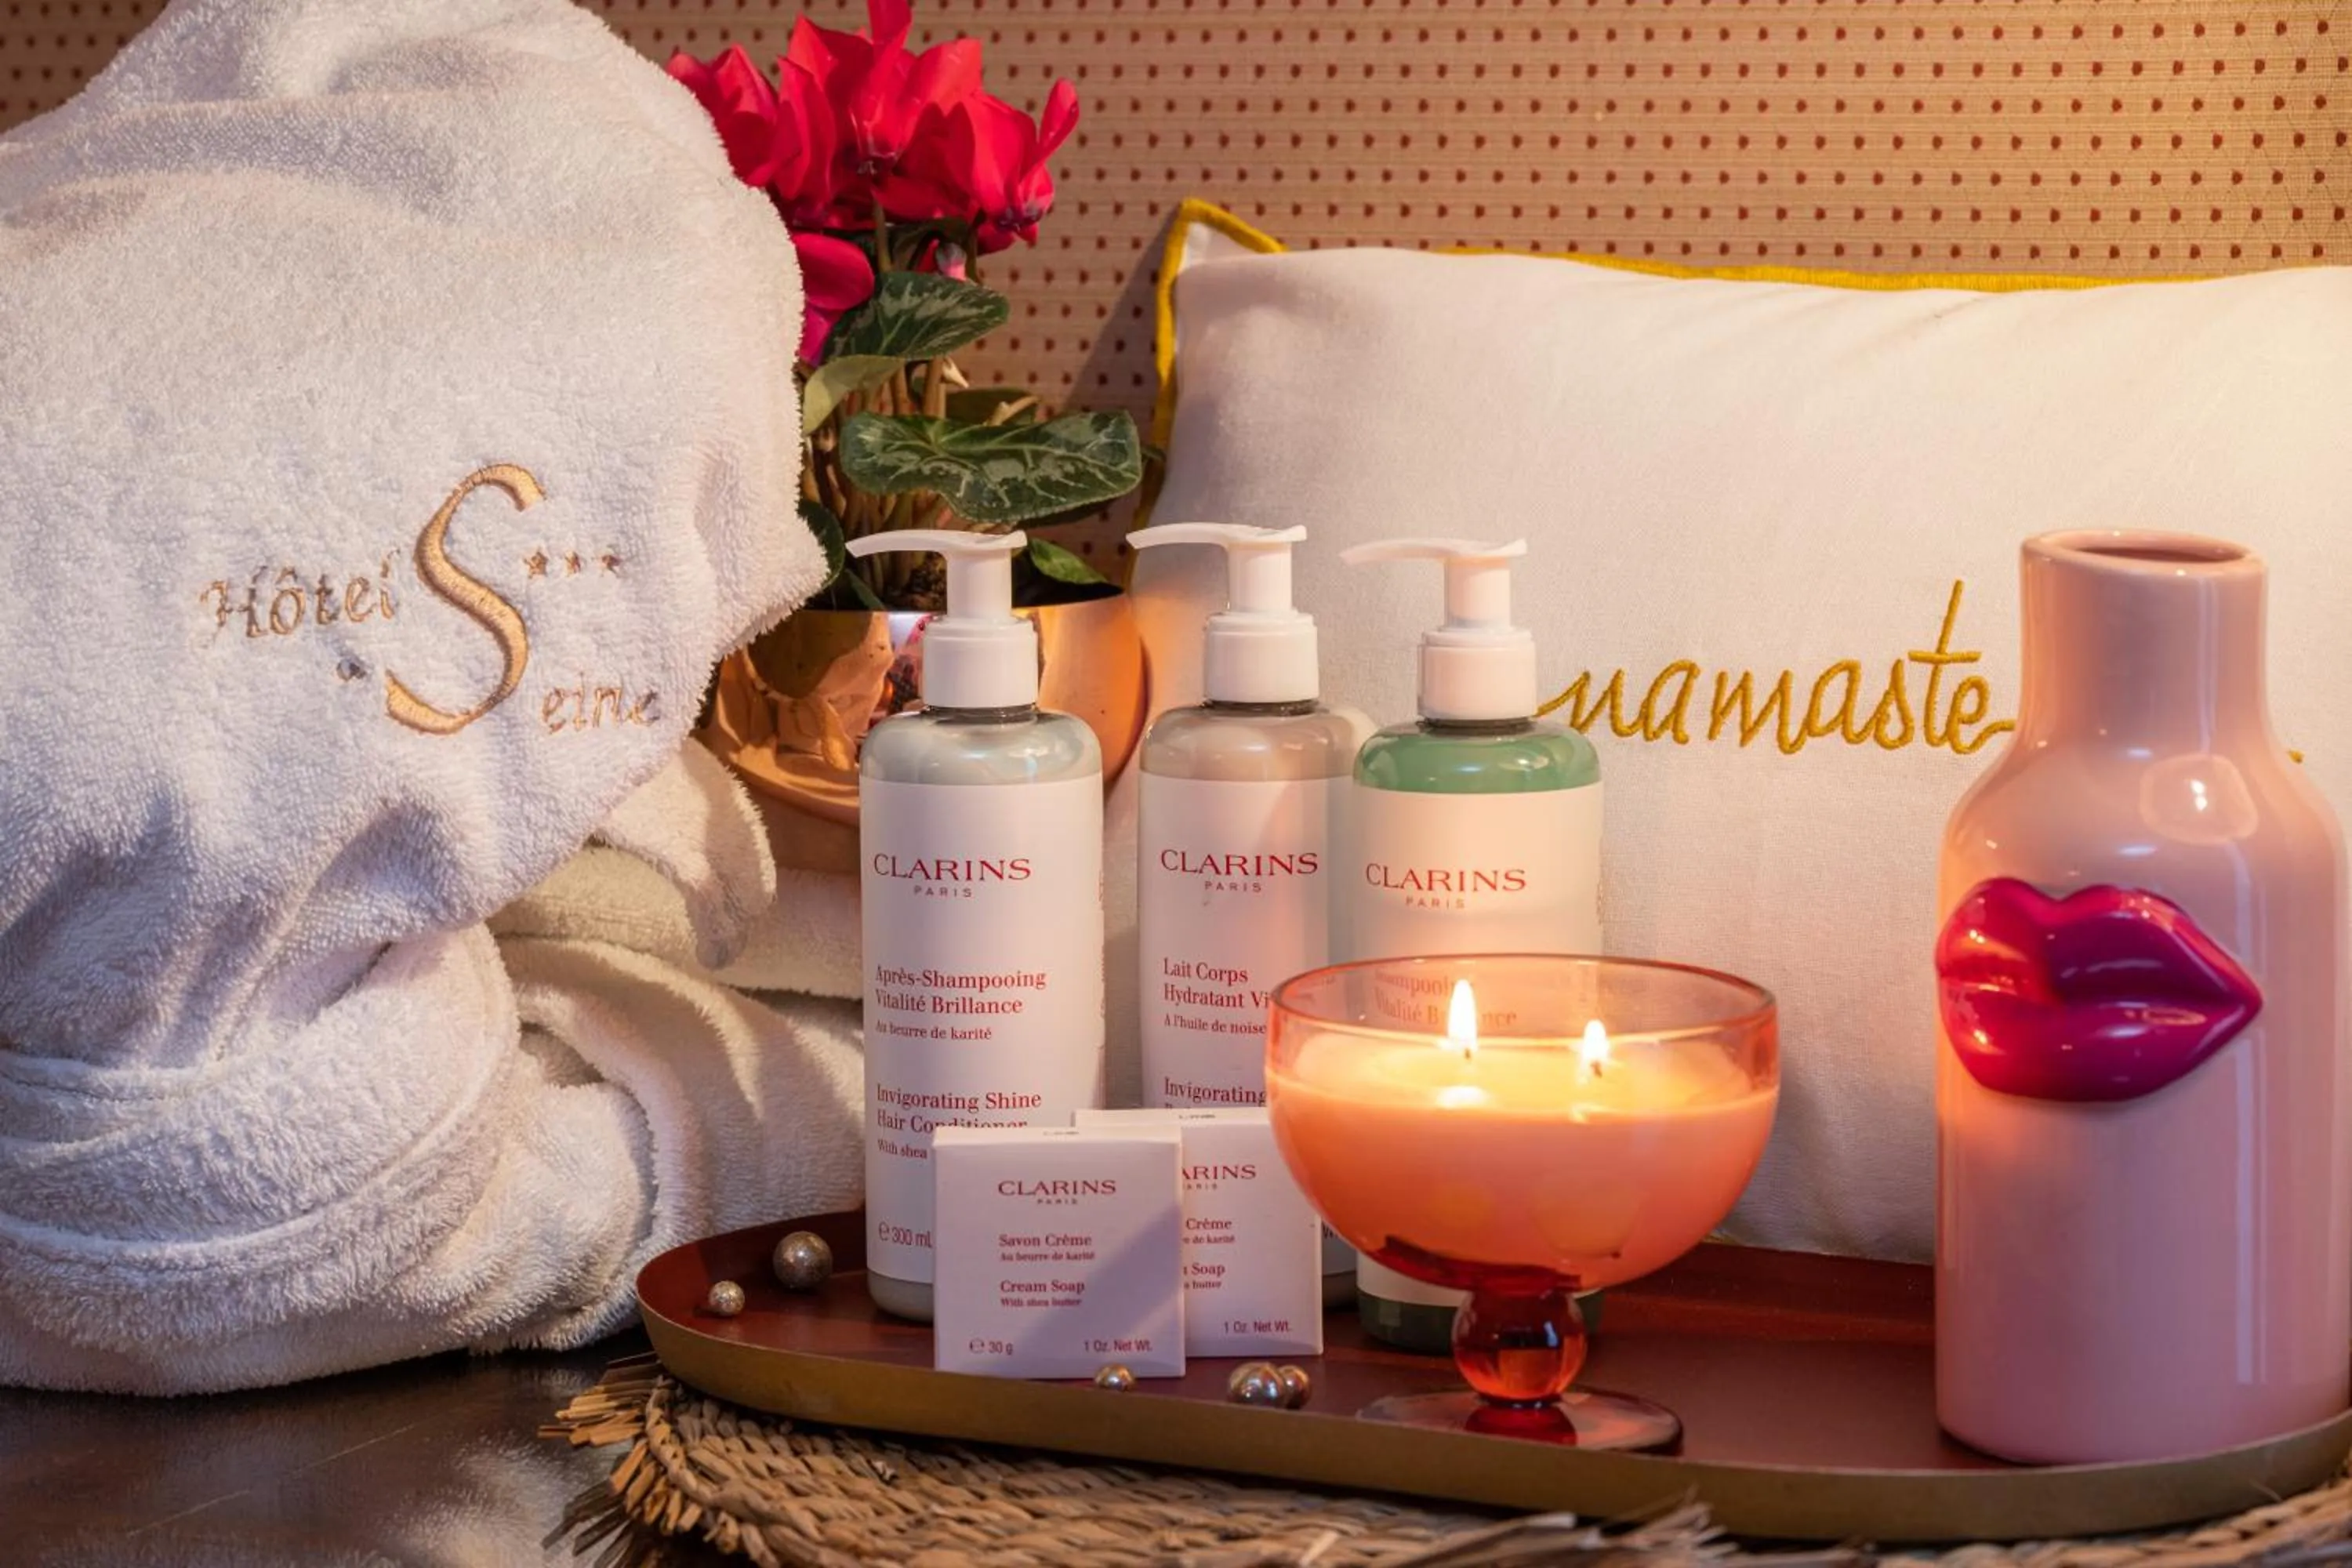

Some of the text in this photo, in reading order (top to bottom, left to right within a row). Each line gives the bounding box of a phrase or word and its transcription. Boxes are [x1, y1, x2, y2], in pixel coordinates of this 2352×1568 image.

[1537, 579, 2015, 755] namaste
[873, 853, 1032, 881] CLARINS
[1160, 849, 1319, 877] CLARINS
[1204, 880, 1262, 893] PARIS
[1366, 862, 1527, 892] CLARINS
[913, 884, 973, 898] PARIS
[1406, 897, 1465, 909] PARIS
[876, 964, 1047, 993] Après-Shampooing
[1163, 957, 1249, 986] Lait Corps
[876, 989, 1023, 1014] Vitalité Brillance
[1163, 982, 1245, 1008] Hydratant
[889, 1020, 927, 1039] beurre
[931, 1025, 947, 1040] de
[950, 1026, 993, 1040] karité
[1211, 1018, 1227, 1033] de
[1229, 1021, 1268, 1034] noise
[877, 1083, 1042, 1113] Invigorating Shine
[877, 1108, 906, 1131] Hair
[877, 1138, 928, 1160] With shea
[998, 1179, 1116, 1196] CLARINS
[1185, 1218, 1232, 1230] Crème
[892, 1226, 913, 1246] 300
[999, 1232, 1092, 1247] Savon Crème
[1192, 1262, 1225, 1277] Soap
[1000, 1279, 1085, 1295] Cream Soap
[1254, 1321, 1271, 1333] Net
[989, 1341, 1003, 1353] 30
[1006, 1341, 1014, 1356] g
[1113, 1339, 1131, 1352] Net
